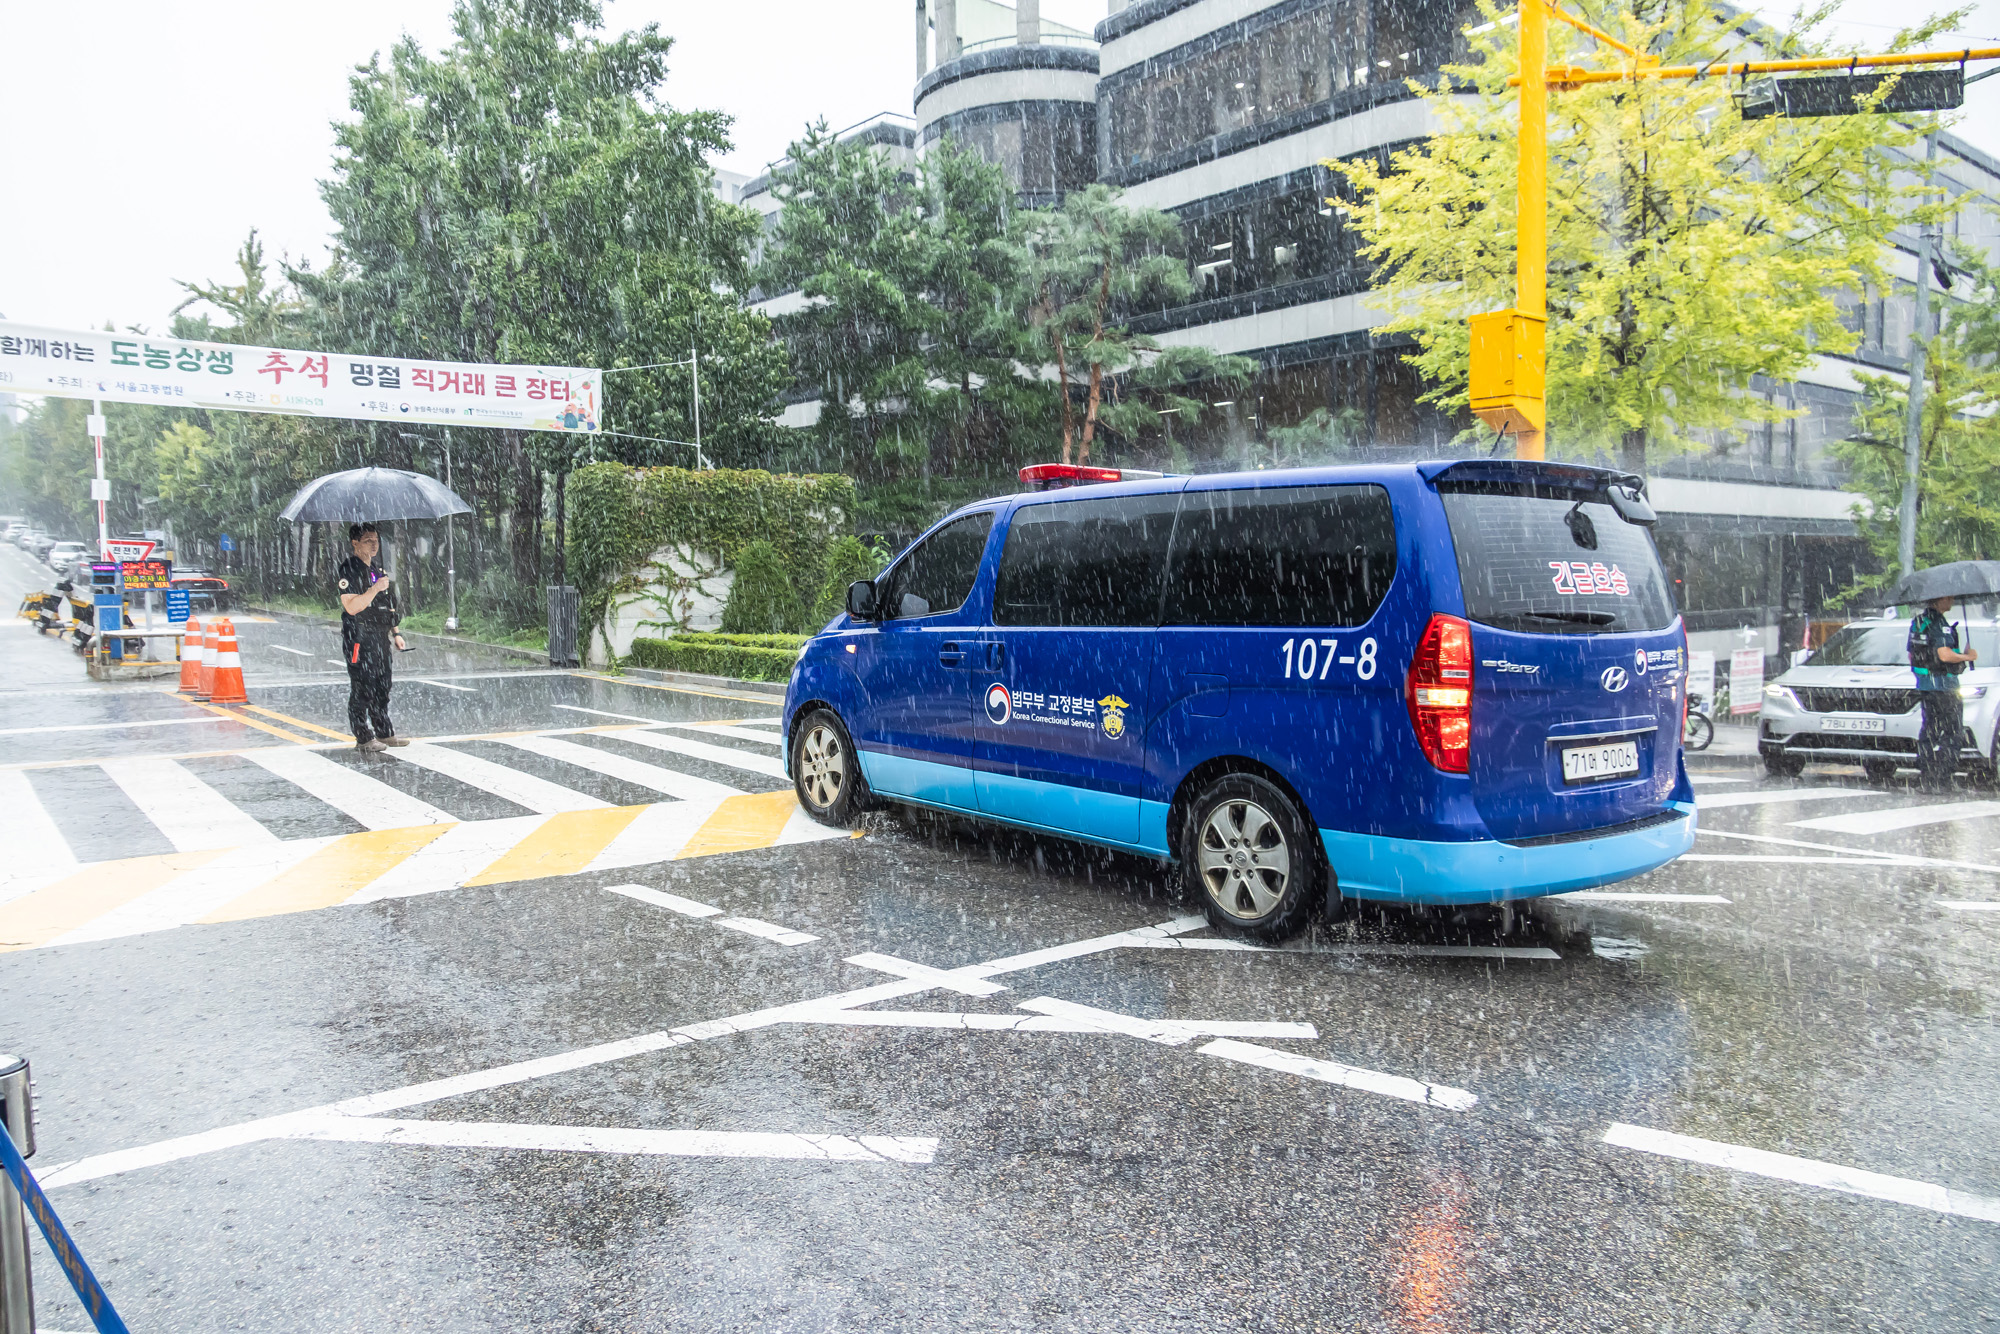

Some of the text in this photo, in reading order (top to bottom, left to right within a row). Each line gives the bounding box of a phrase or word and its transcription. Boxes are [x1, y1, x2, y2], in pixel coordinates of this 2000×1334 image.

[0, 335, 570, 402] 함께하는 도농상생 추석 명절 직거래 큰 장터
[115, 381, 184, 397] 서울고등법원
[1548, 561, 1630, 596] 긴급호송
[1282, 637, 1378, 680] 107-8
[1496, 659, 1541, 674] Starex
[1012, 690, 1096, 716] 법무부 교정본부
[1012, 711, 1096, 729] Korea Correctional Service
[1851, 720, 1878, 729] 6139
[1602, 747, 1632, 770] 9006
